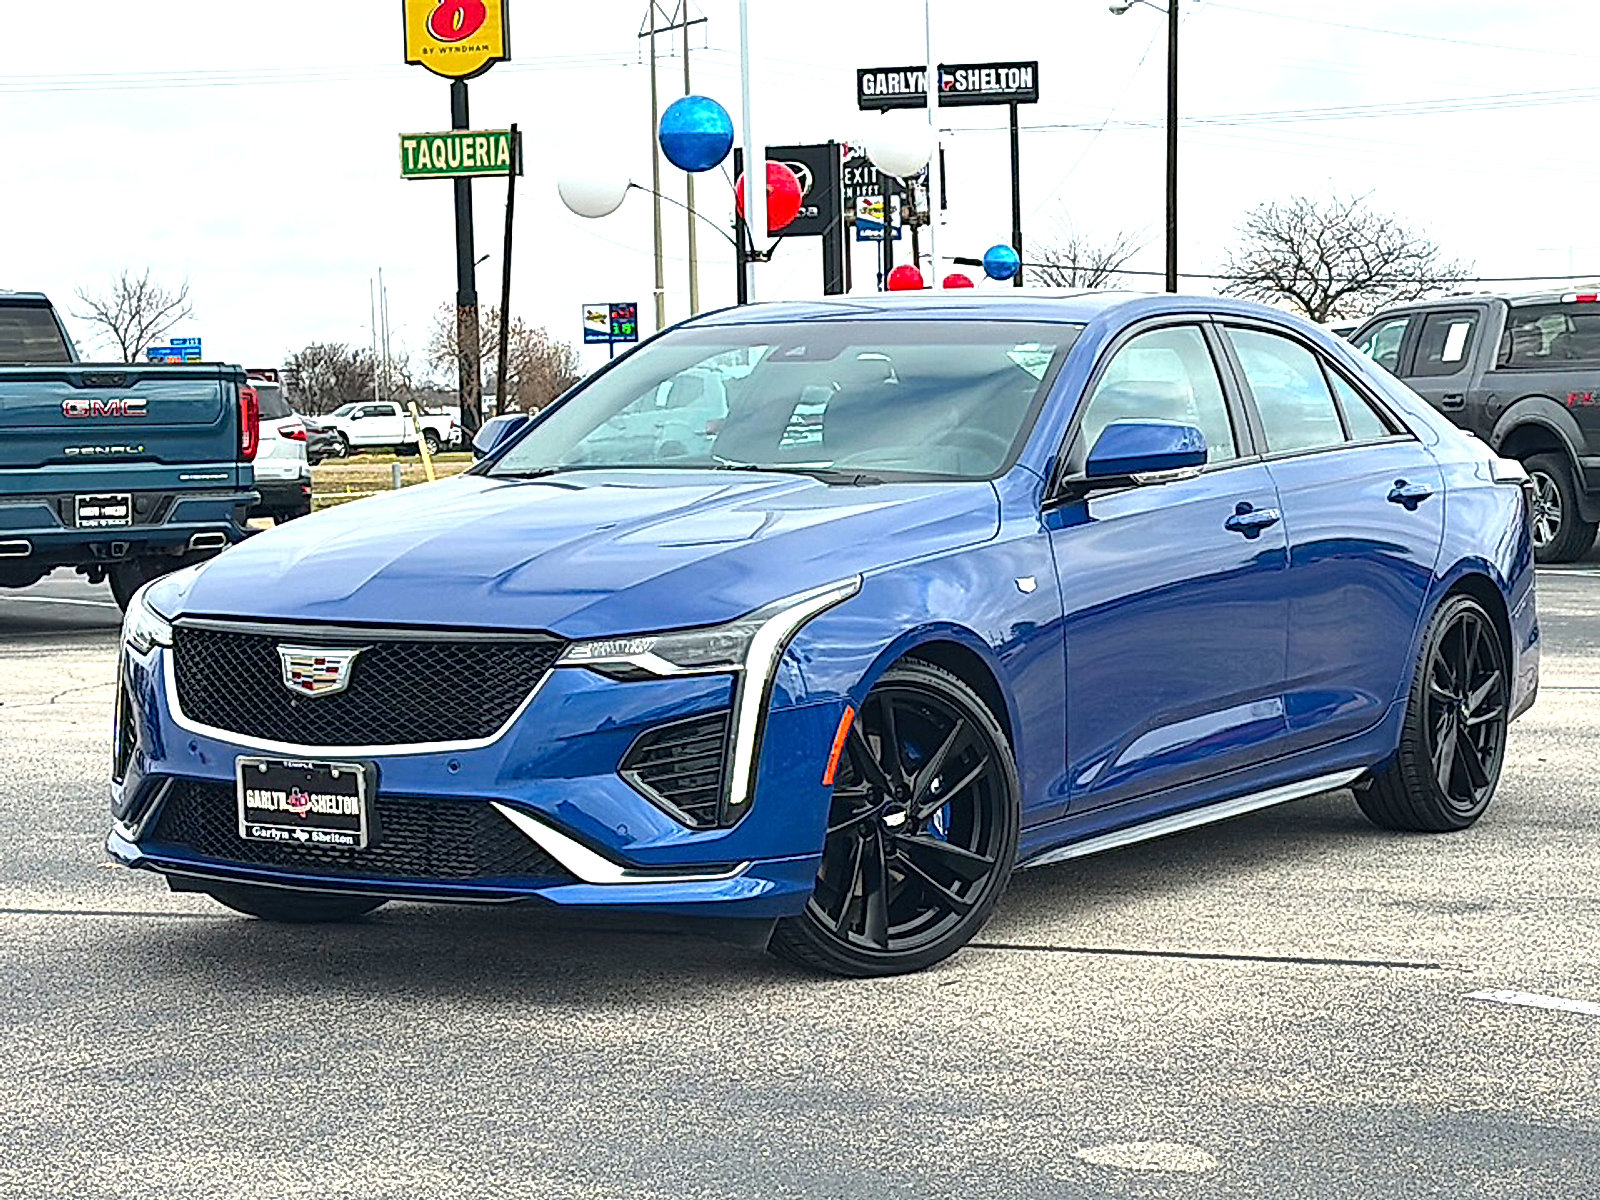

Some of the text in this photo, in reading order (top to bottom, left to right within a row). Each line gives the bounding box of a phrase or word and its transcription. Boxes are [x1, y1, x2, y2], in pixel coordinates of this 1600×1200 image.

[422, 44, 490, 55] BY WYNDHAM
[955, 66, 1034, 91] SHELTON
[403, 135, 510, 171] TAQUERIA
[844, 167, 878, 185] EXIT
[62, 399, 148, 418] GMC
[246, 789, 360, 815] GARLYN SHELTON
[252, 826, 354, 844] Garlyn Shelton
